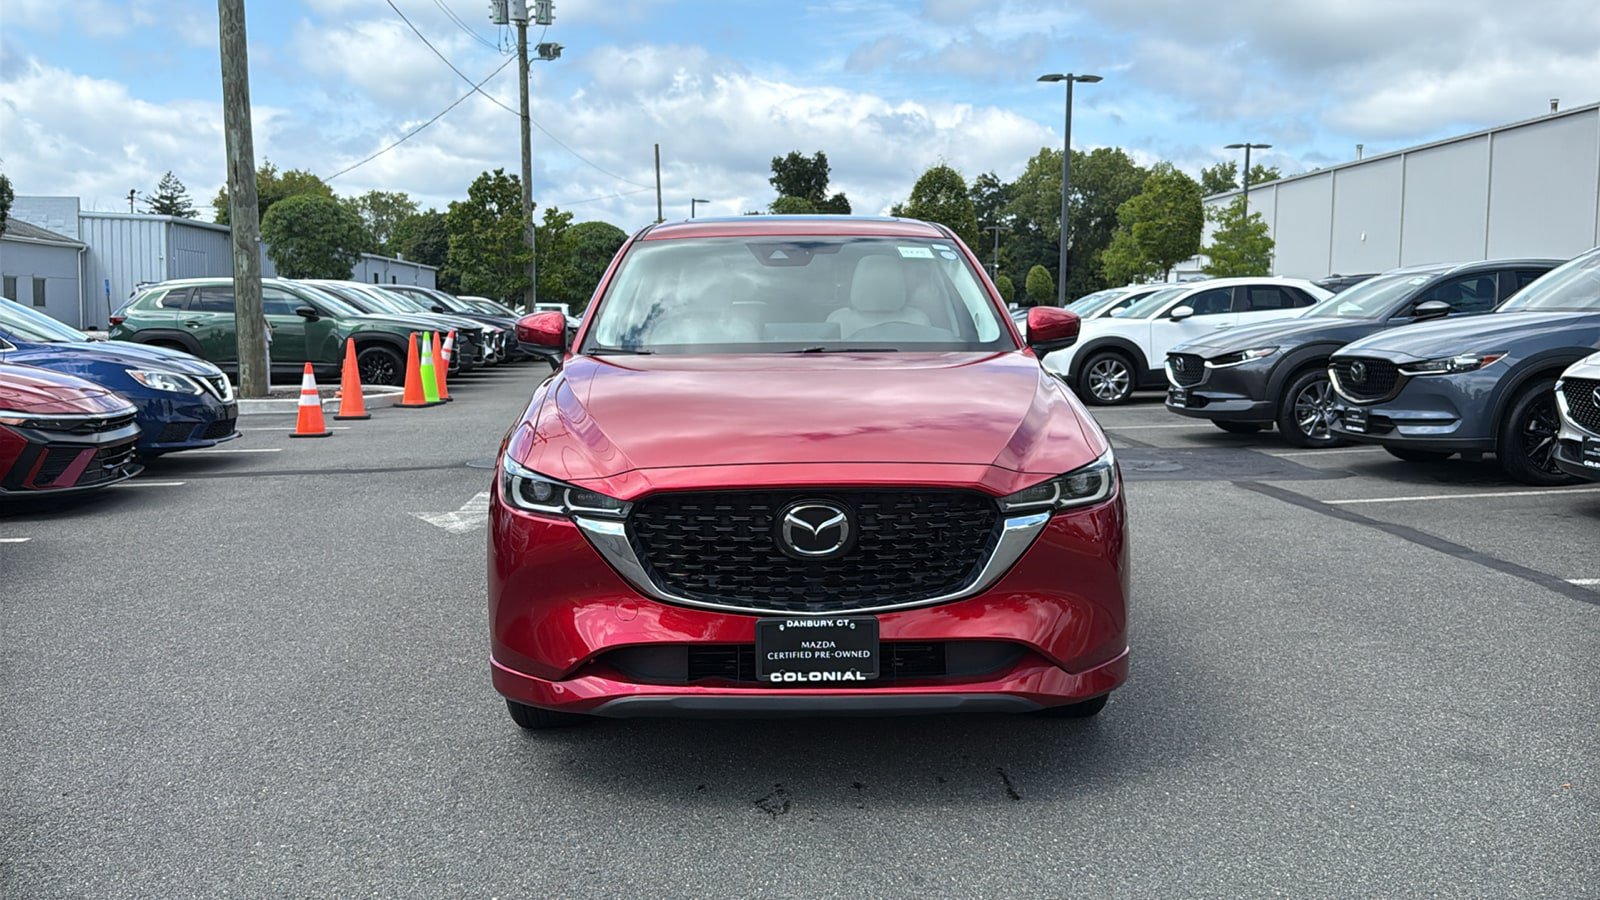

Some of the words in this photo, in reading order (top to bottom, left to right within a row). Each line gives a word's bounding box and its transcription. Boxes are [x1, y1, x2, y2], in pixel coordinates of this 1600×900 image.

[836, 619, 850, 627] CT
[801, 641, 836, 649] MAZDA
[767, 651, 812, 660] CERTIFIED
[815, 650, 870, 659] PRE-OWNED
[770, 671, 866, 682] COLONIAL
